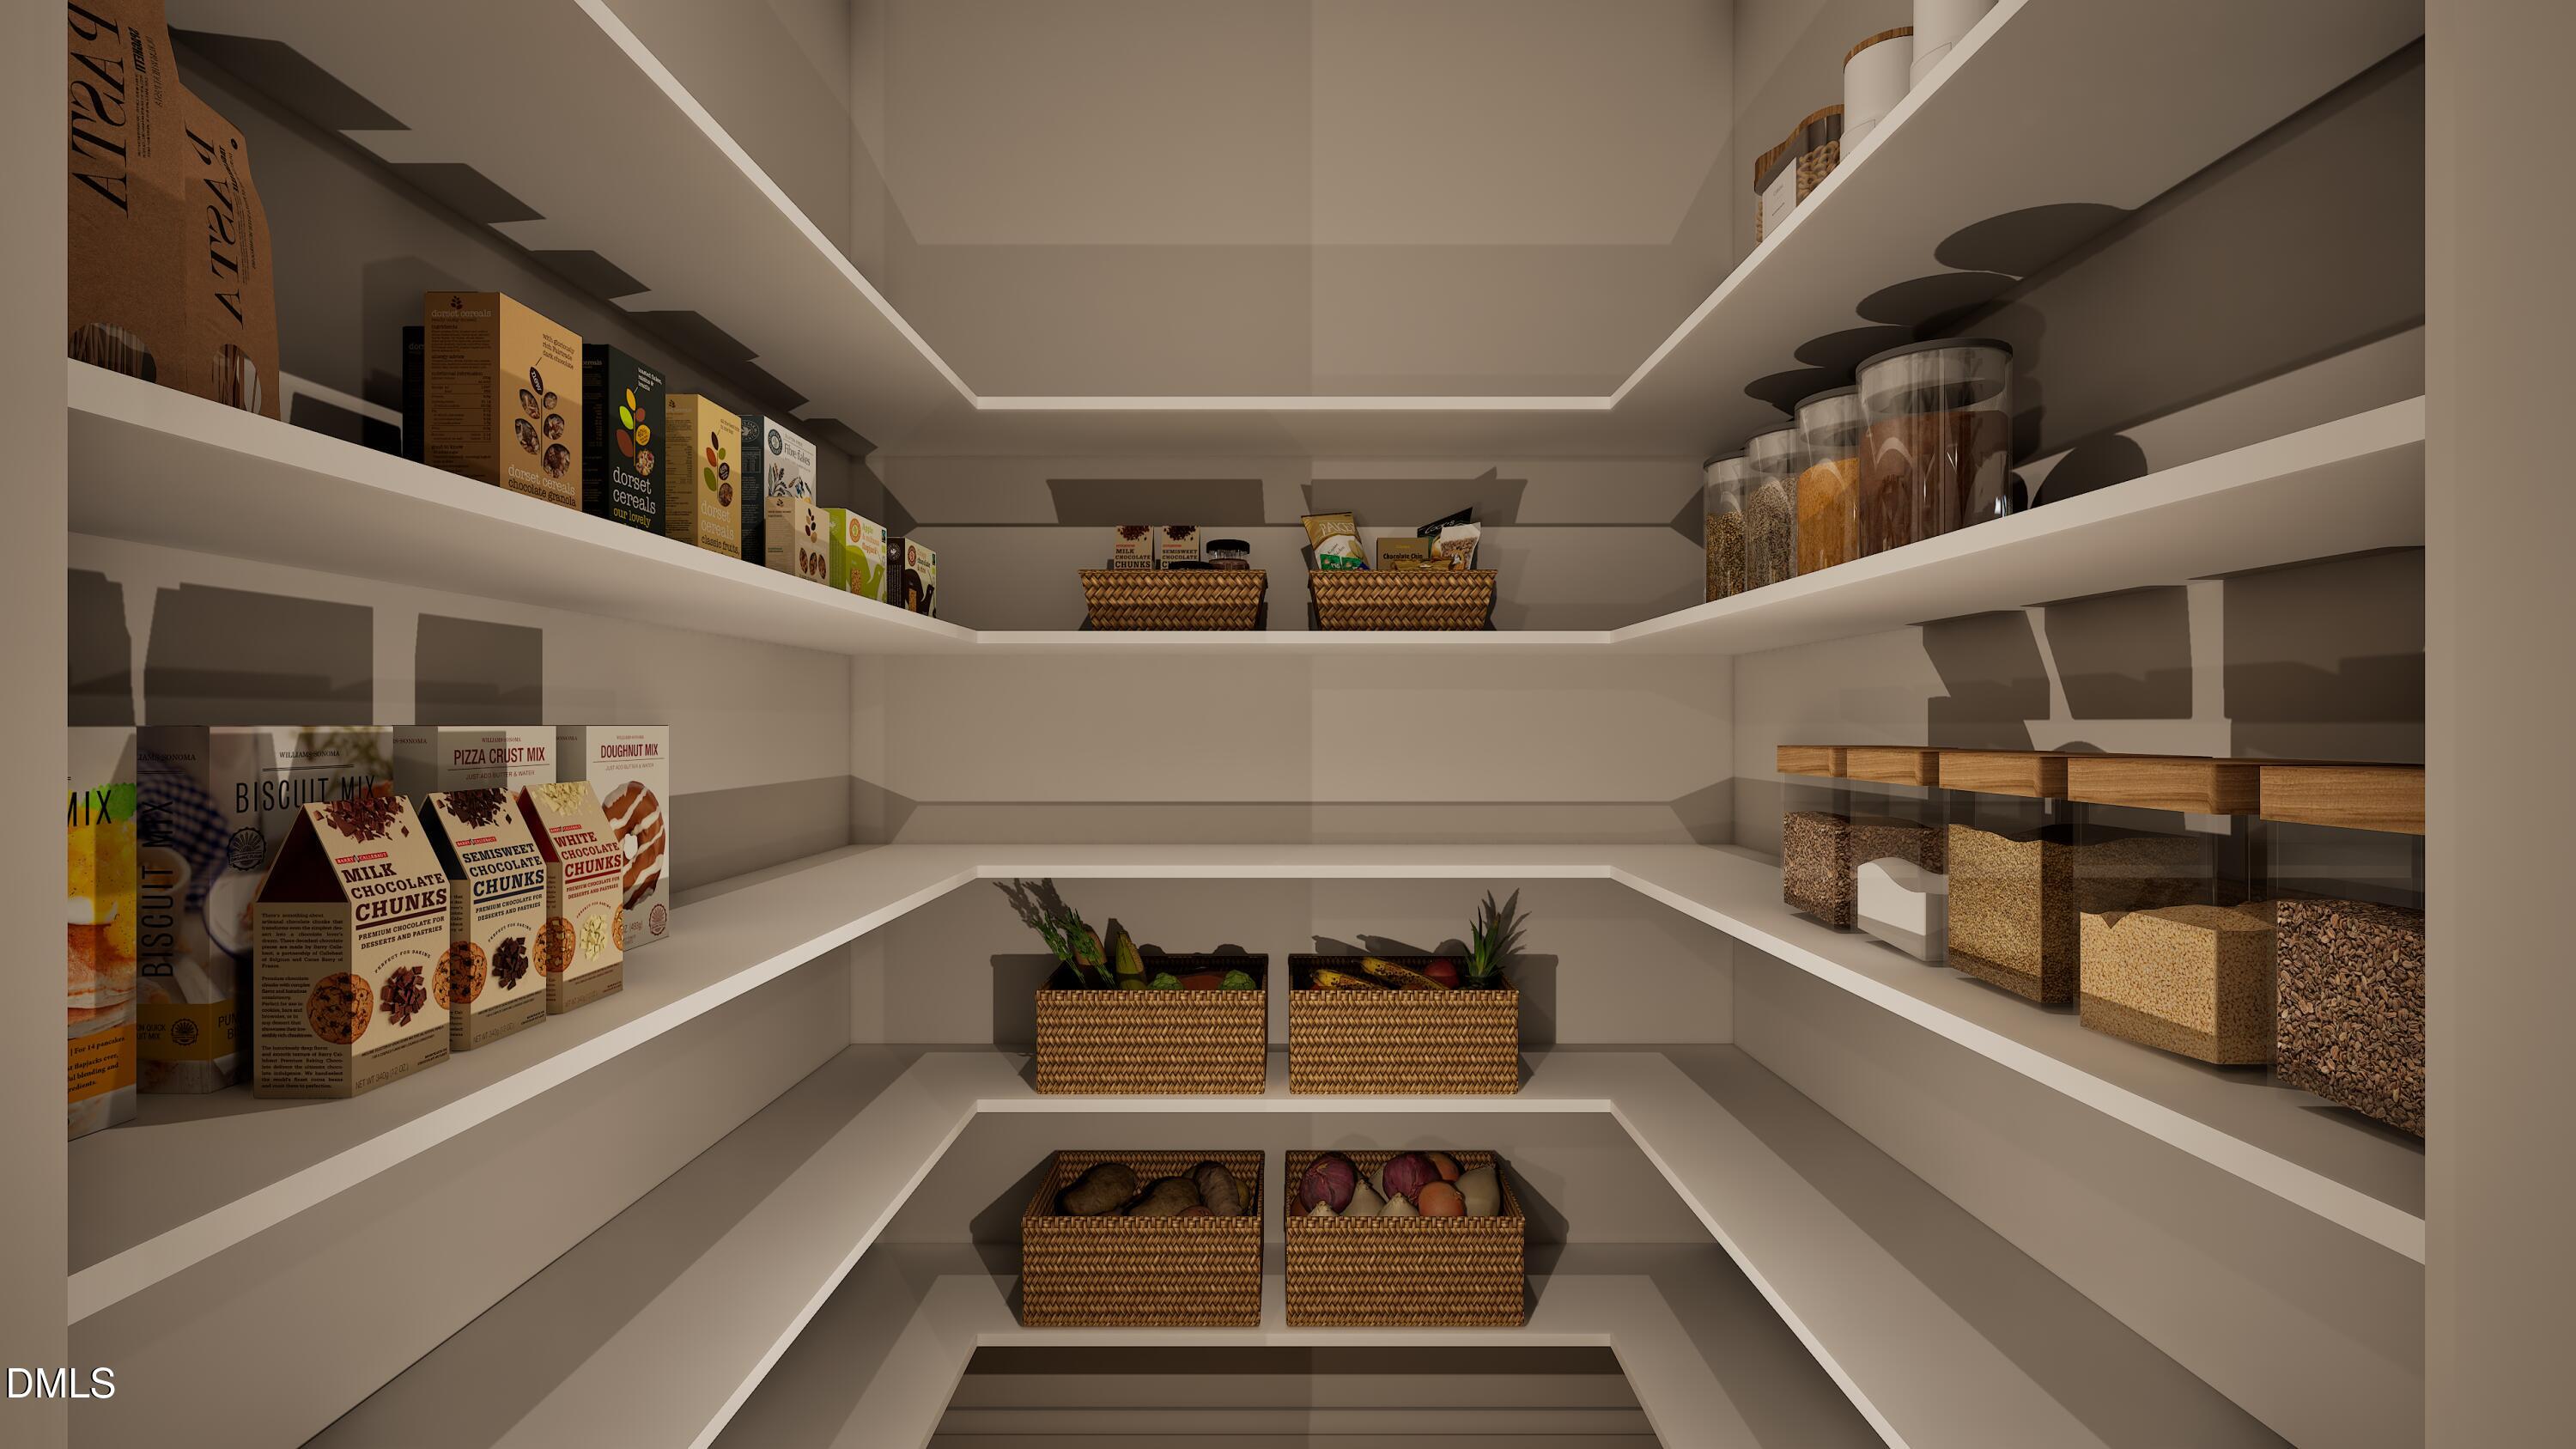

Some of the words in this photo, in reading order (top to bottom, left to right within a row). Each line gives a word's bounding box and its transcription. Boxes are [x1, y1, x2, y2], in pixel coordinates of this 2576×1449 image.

[531, 371, 542, 391] new
[784, 442, 797, 459] Fibre
[508, 464, 541, 484] dorset
[542, 477, 575, 496] cereals
[613, 466, 652, 495] dorset
[508, 478, 547, 497] chocolate
[548, 491, 576, 507] granola
[613, 489, 656, 514] cereals
[613, 508, 628, 519] our
[629, 510, 651, 528] lovely
[701, 500, 731, 522] dorset
[701, 520, 734, 540] cereals
[702, 534, 722, 549] classic
[453, 749, 486, 765] PIZZA
[489, 747, 524, 764] CRUST
[526, 746, 545, 762] MIX
[601, 744, 643, 758] DOUGHNUT
[645, 743, 659, 756] MIX
[236, 777, 329, 813] BISCUIT
[342, 776, 375, 801] MIX
[142, 801, 173, 848] MIX
[554, 831, 597, 848] WHITE
[462, 843, 535, 863] SEMISWEET
[561, 842, 619, 860] CHOCOLATE
[341, 862, 397, 884] MILK
[470, 855, 543, 877] CHOCOLATE
[565, 855, 621, 878] CHUNKS
[350, 873, 445, 899] CHOCOLATE
[473, 869, 544, 897] CHUNKS
[567, 883, 587, 892] PREMIUM
[587, 879, 611, 888] CHOCOLATE
[355, 888, 447, 922] CHUNKS
[476, 902, 501, 913] PREMIUM
[501, 897, 532, 908] CHOCOLATE
[568, 891, 590, 899] DESSERTS
[142, 865, 173, 977] BISCUIT
[477, 910, 505, 922] DESSERTS
[517, 902, 541, 912] PASTRIES
[358, 928, 392, 941] PREMIUM
[392, 919, 431, 933] CHOCOLATE
[433, 916, 445, 924] FOR
[361, 936, 396, 950] DESSERTS
[397, 932, 411, 941] AND
[412, 925, 442, 937] PASTRIES
[74, 1044, 87, 1055] For
[88, 1042, 95, 1050] 14
[96, 1037, 125, 1050] pancakes
[74, 1056, 103, 1072] flapjacks
[77, 1065, 106, 1081] blending
[106, 1062, 119, 1070] and
